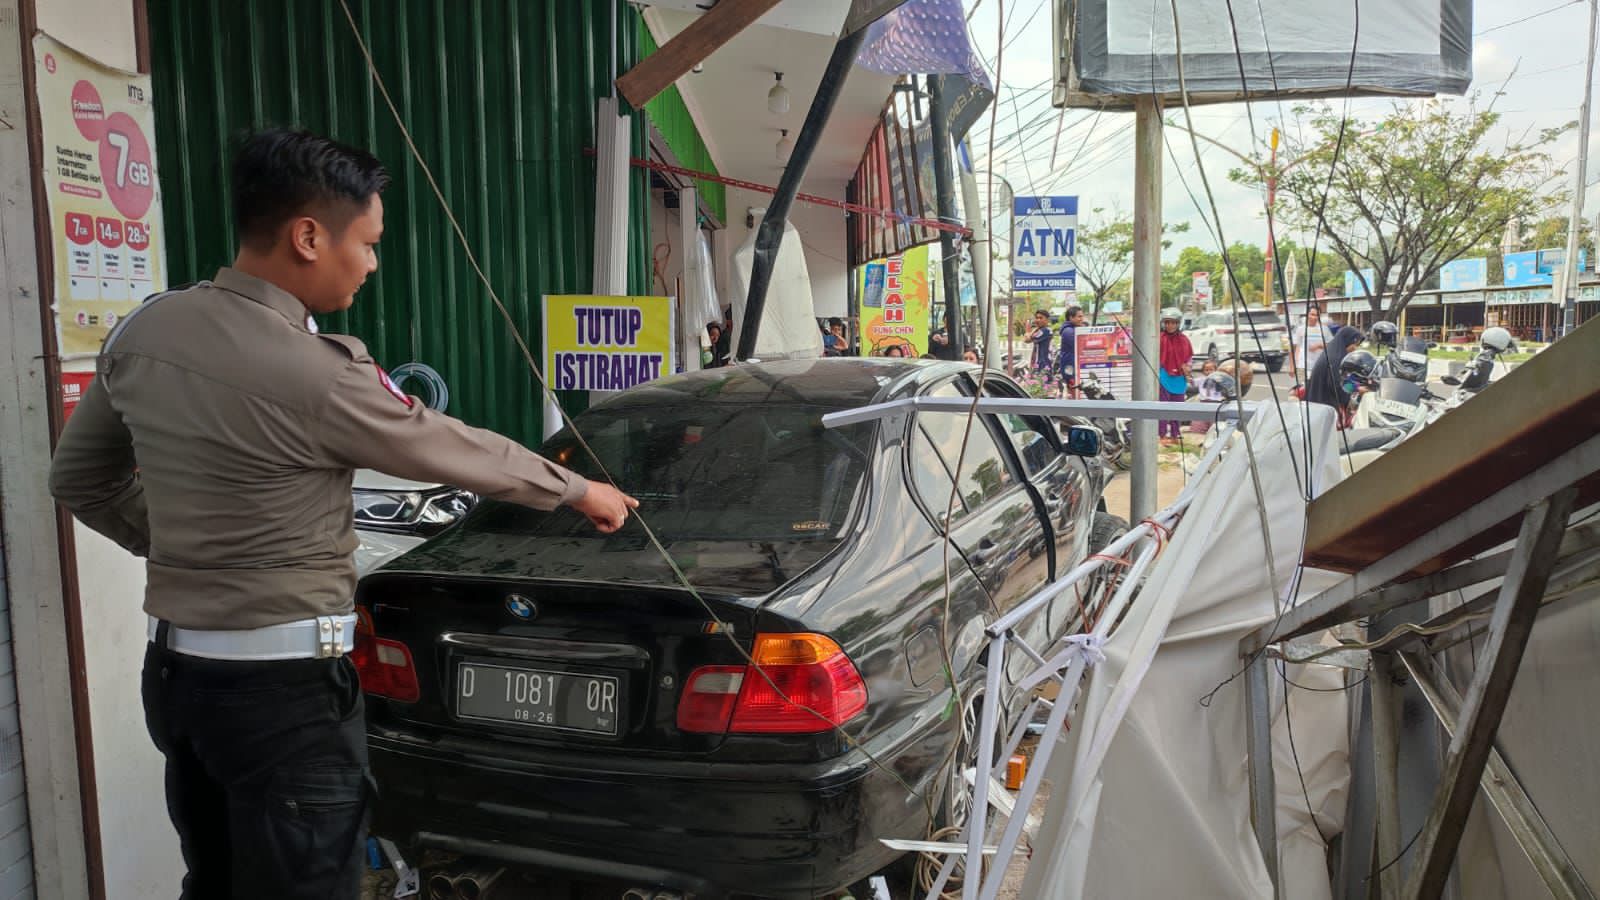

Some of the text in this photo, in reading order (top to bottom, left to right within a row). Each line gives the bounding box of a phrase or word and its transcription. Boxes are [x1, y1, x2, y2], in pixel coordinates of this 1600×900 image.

[1017, 228, 1075, 257] ATM
[1015, 279, 1074, 288] ZAHRA PONSEL
[573, 306, 642, 346] TUTUP
[554, 352, 663, 391] ISTIRAHAT
[461, 666, 476, 698] D
[503, 671, 555, 707] 1081
